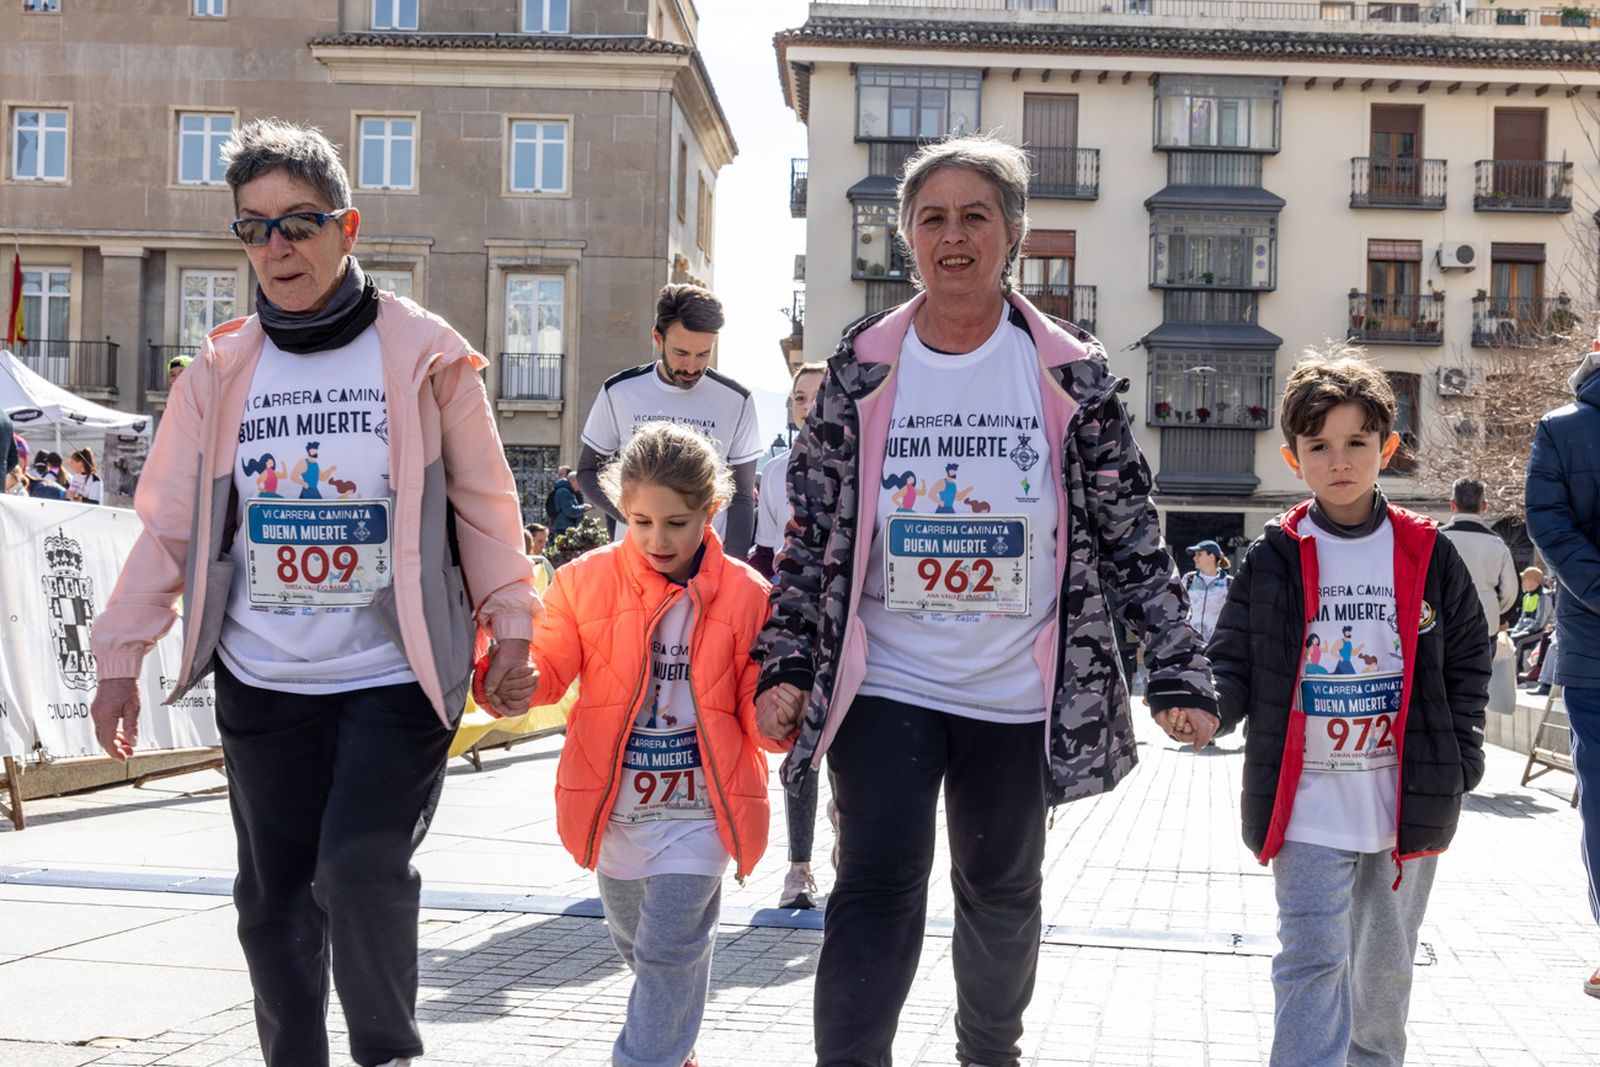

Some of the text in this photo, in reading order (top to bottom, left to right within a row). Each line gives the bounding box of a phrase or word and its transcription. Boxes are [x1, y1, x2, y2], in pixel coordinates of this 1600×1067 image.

[253, 389, 322, 409] CARRERA
[296, 411, 372, 436] MUERTE
[898, 413, 962, 429] CARRERA
[967, 413, 1039, 430] CAMINATA
[884, 436, 1007, 459] UENA MUERTE
[262, 509, 371, 520] VI CARRERA CAMINATA
[262, 524, 348, 540] BUENA MUERTE
[904, 524, 1010, 535] VI CARRERA CAMINATA
[904, 538, 987, 554] BUENA MUERTE
[277, 545, 359, 584] 809
[917, 558, 994, 593] 962
[1356, 584, 1396, 598] CAMIN
[1335, 602, 1387, 621] MUERTE
[1312, 685, 1321, 695] VI
[1322, 684, 1363, 695] CARRERA
[47, 702, 88, 720] CIUDAD
[172, 695, 204, 711] eportes
[1314, 695, 1387, 713] BUENA MUERTE
[1326, 714, 1392, 751] 972
[631, 737, 667, 749] CARRERA
[652, 750, 694, 767] MUERTE
[633, 770, 695, 804] 971
